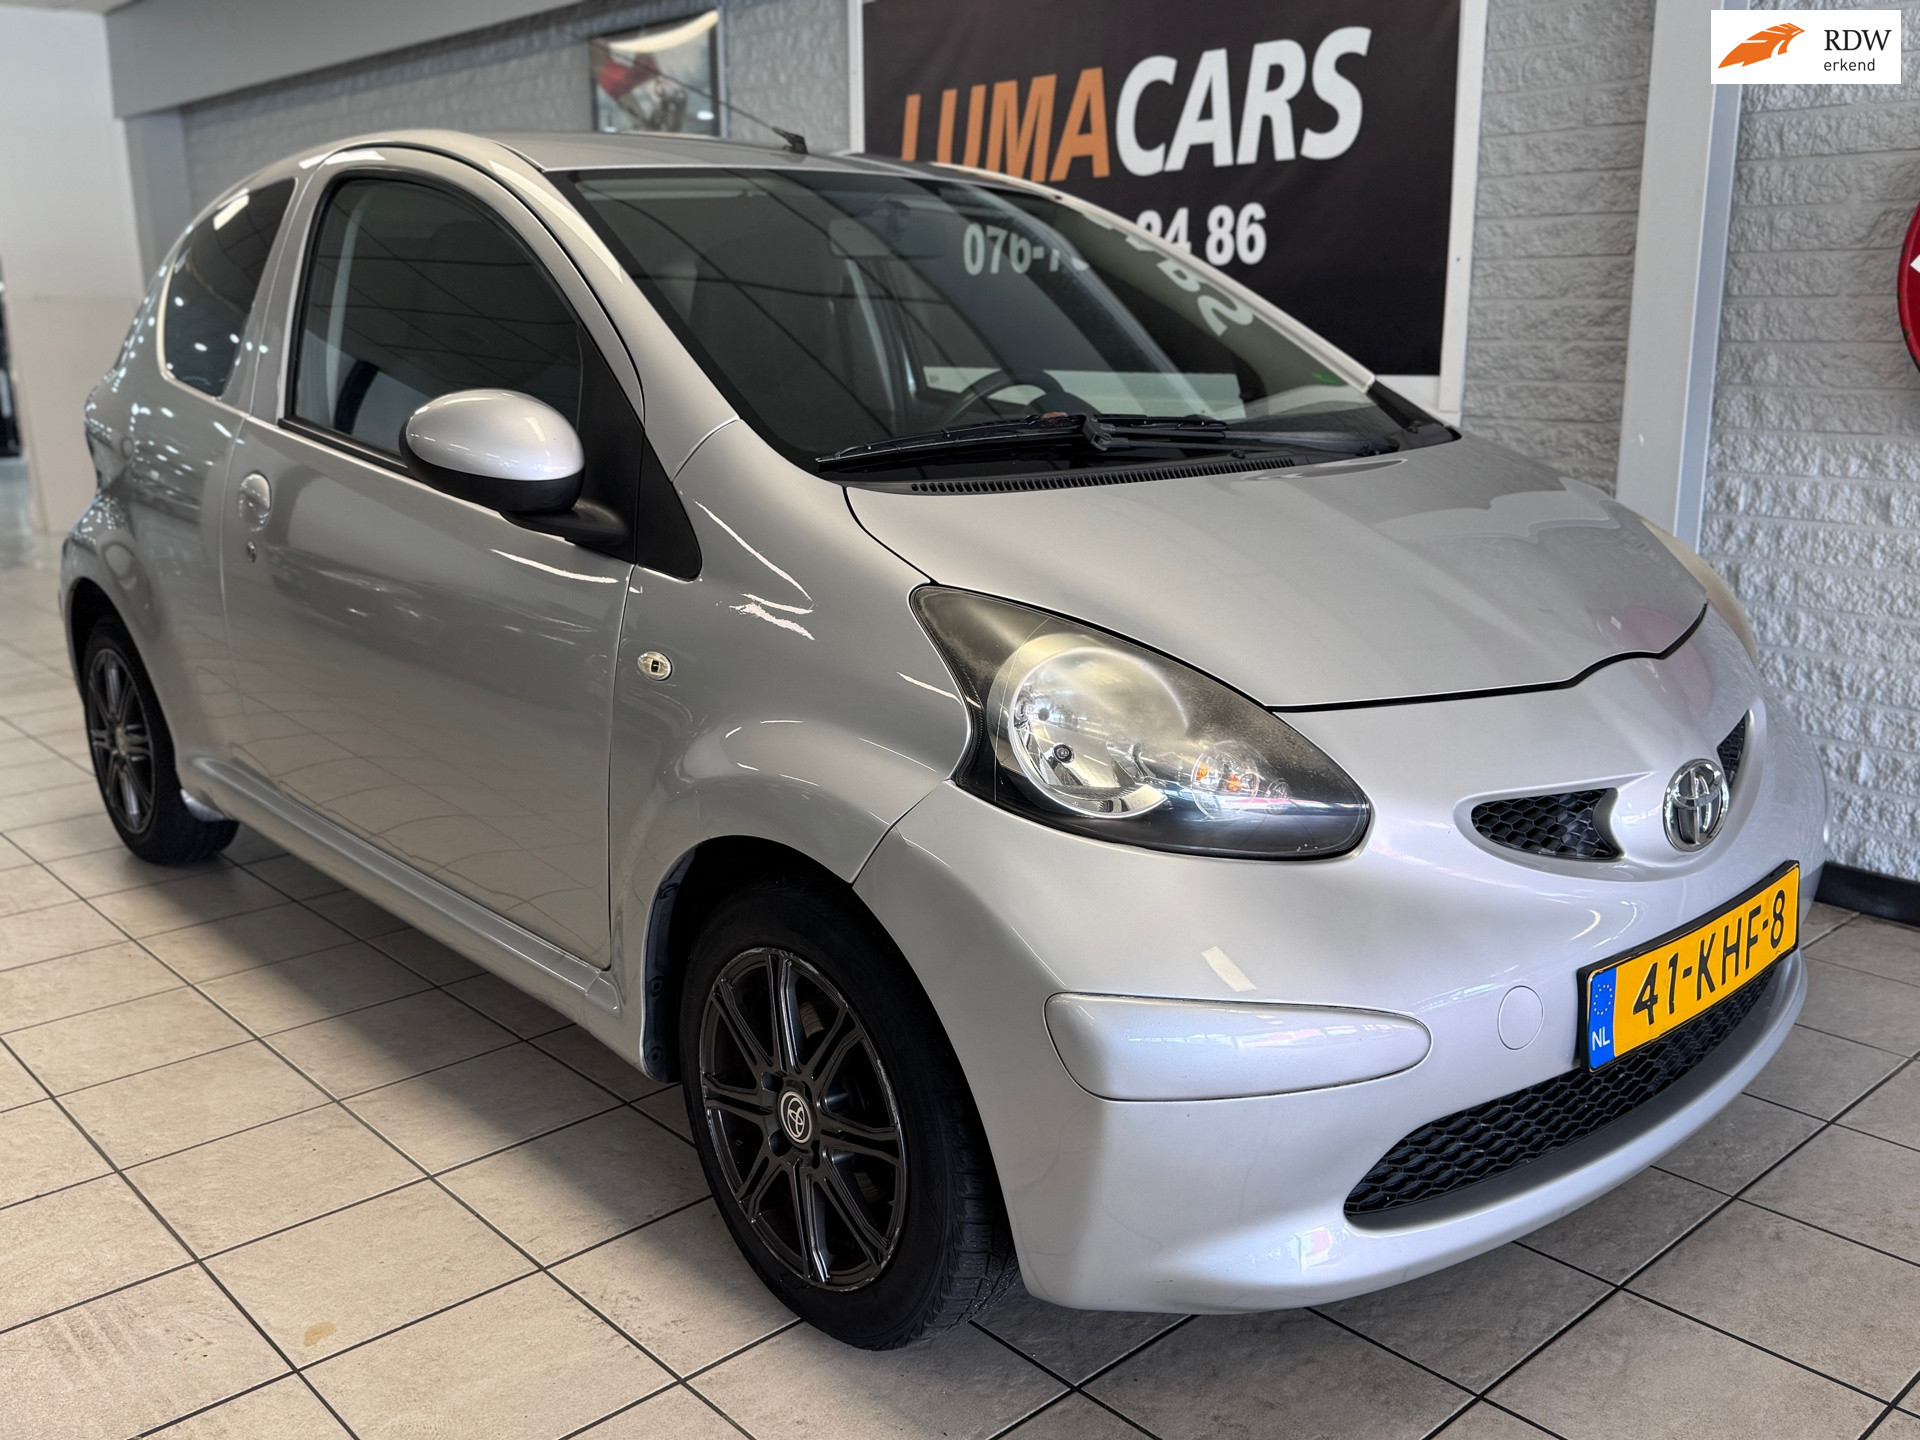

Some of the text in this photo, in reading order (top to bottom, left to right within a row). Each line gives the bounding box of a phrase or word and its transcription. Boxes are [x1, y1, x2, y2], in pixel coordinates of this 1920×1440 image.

[1205, 202, 1267, 266] 86
[1632, 889, 1786, 1026] 41-KHF-8
[1591, 1026, 1611, 1051] NL
